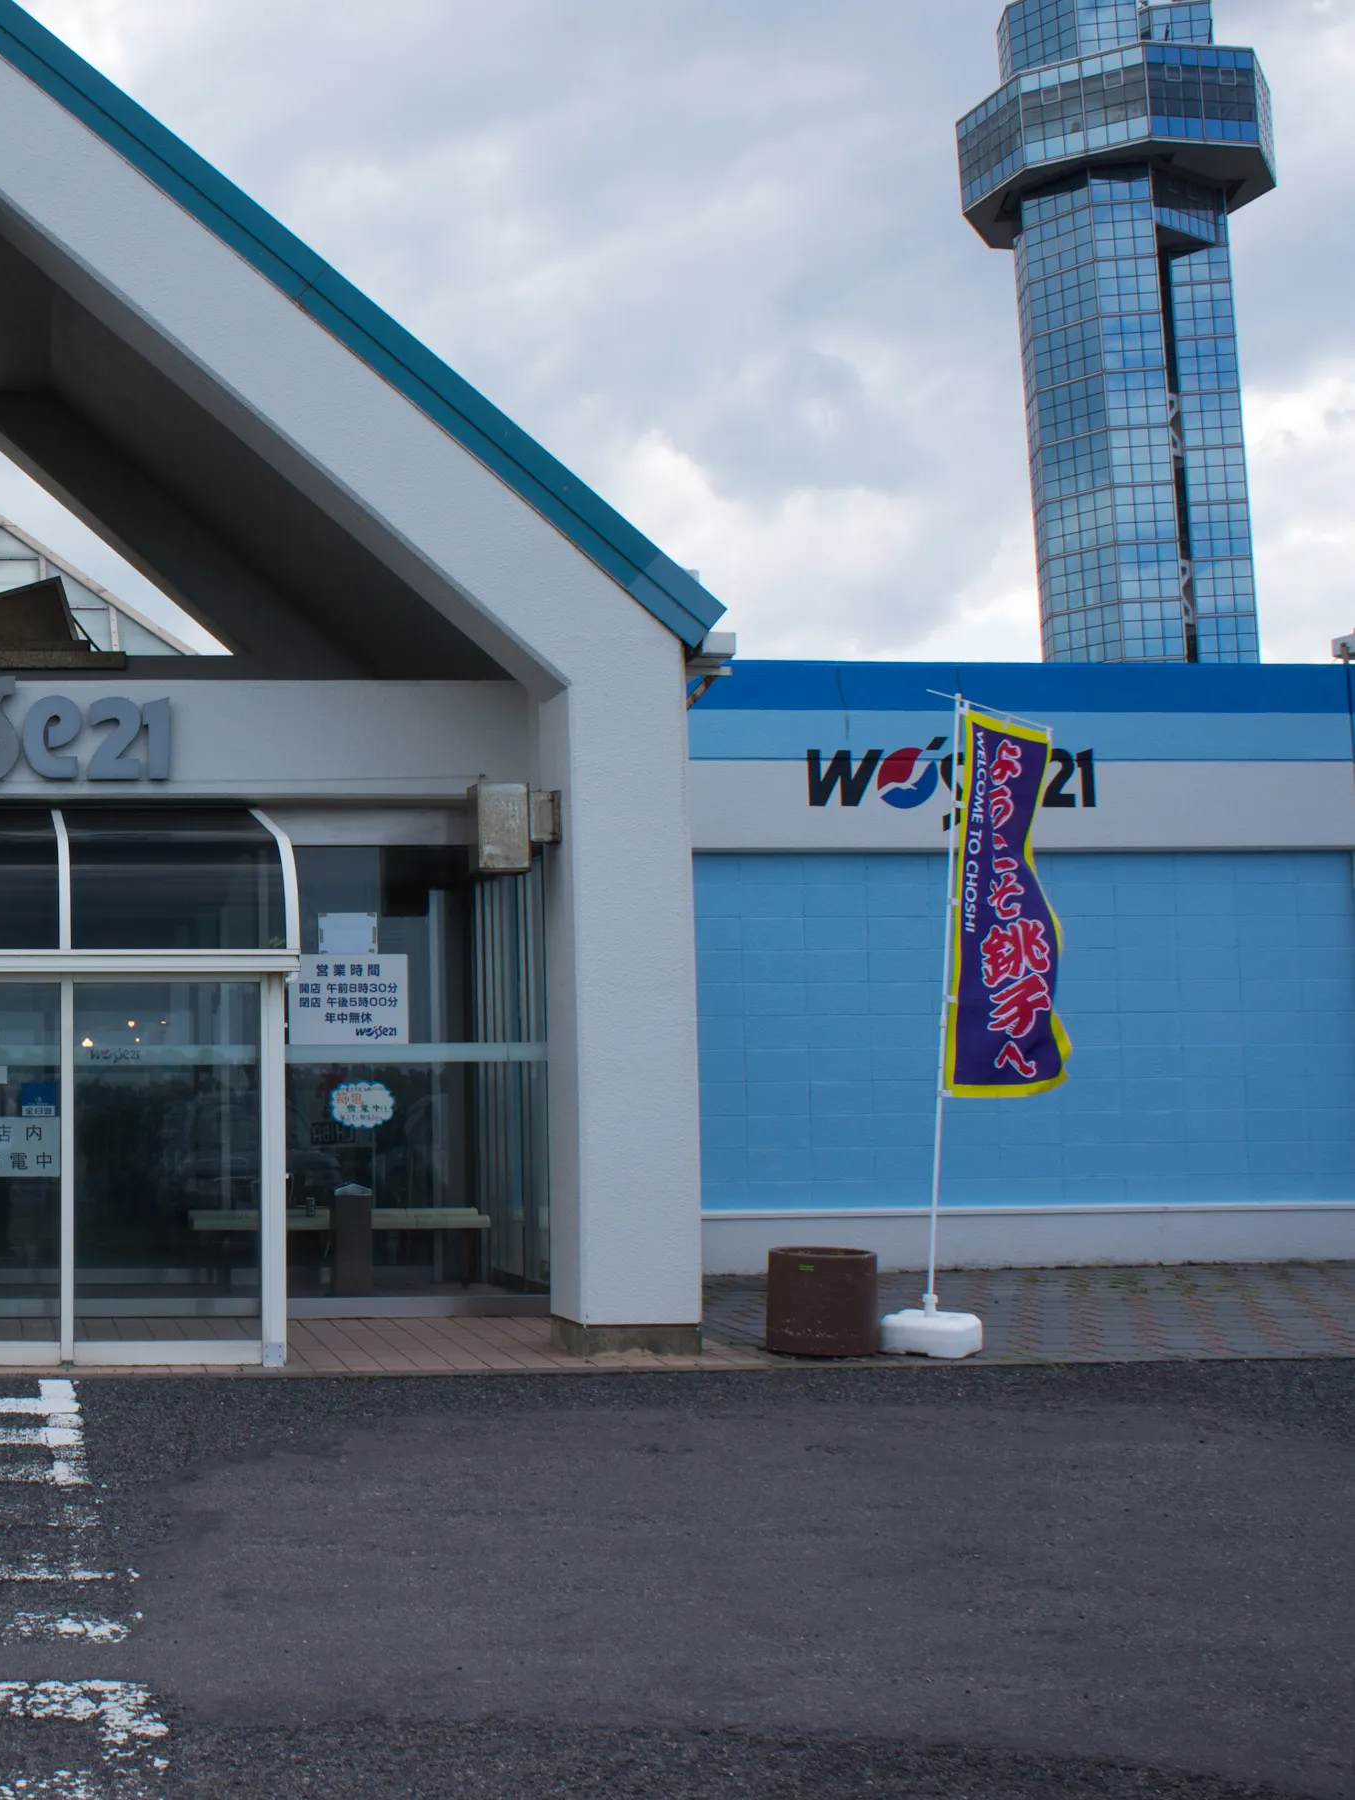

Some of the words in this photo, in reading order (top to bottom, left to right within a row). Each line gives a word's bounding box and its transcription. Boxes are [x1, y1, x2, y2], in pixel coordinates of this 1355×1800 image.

[970, 731, 987, 825] WELCOME
[967, 829, 983, 856] TO
[962, 859, 979, 933] CHOSHI
[980, 738, 1051, 1079] ようこそ銚子へ
[316, 964, 380, 977] 営業時間
[299, 983, 321, 994] 開店
[326, 983, 398, 994] 午前8時30分
[299, 997, 321, 1008] 閉店
[326, 997, 398, 1008] 午後5時00分
[325, 1012, 373, 1024] 年中無休
